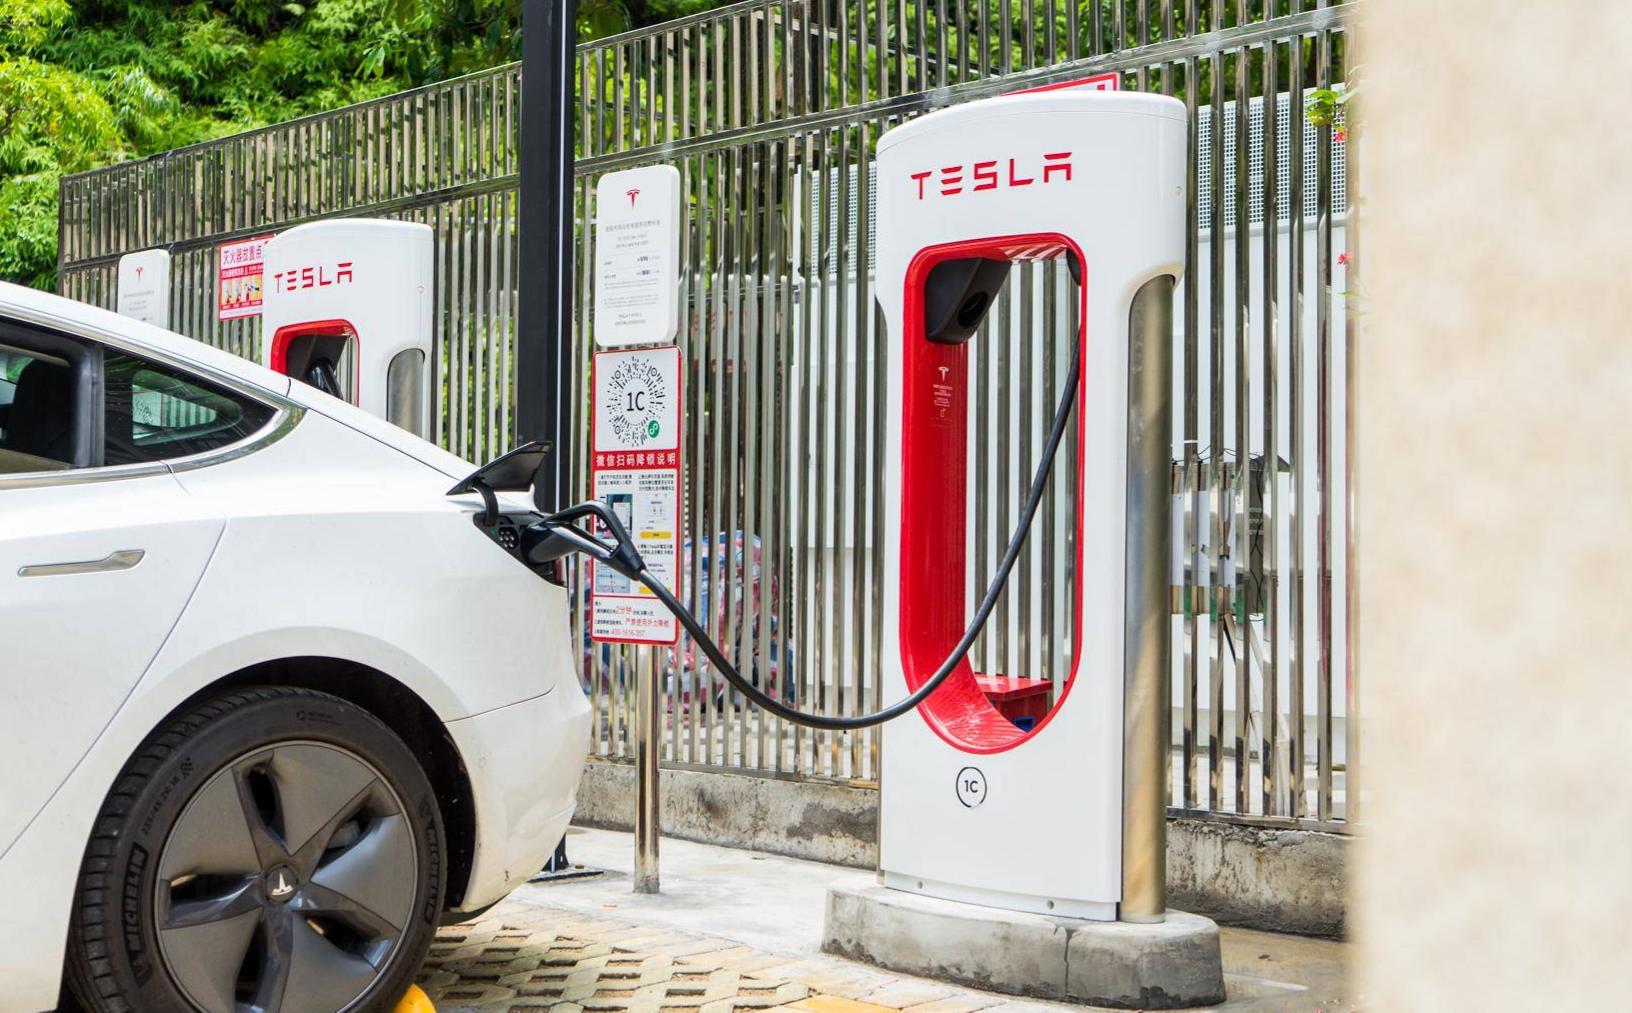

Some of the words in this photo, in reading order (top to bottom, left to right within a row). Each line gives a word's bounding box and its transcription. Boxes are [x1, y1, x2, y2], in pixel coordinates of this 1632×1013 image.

[910, 151, 1073, 200] TESLA
[273, 262, 353, 294] TESLA
[626, 391, 645, 412] 1C
[964, 779, 979, 794] 1C
[125, 847, 146, 949] MICHELIN
